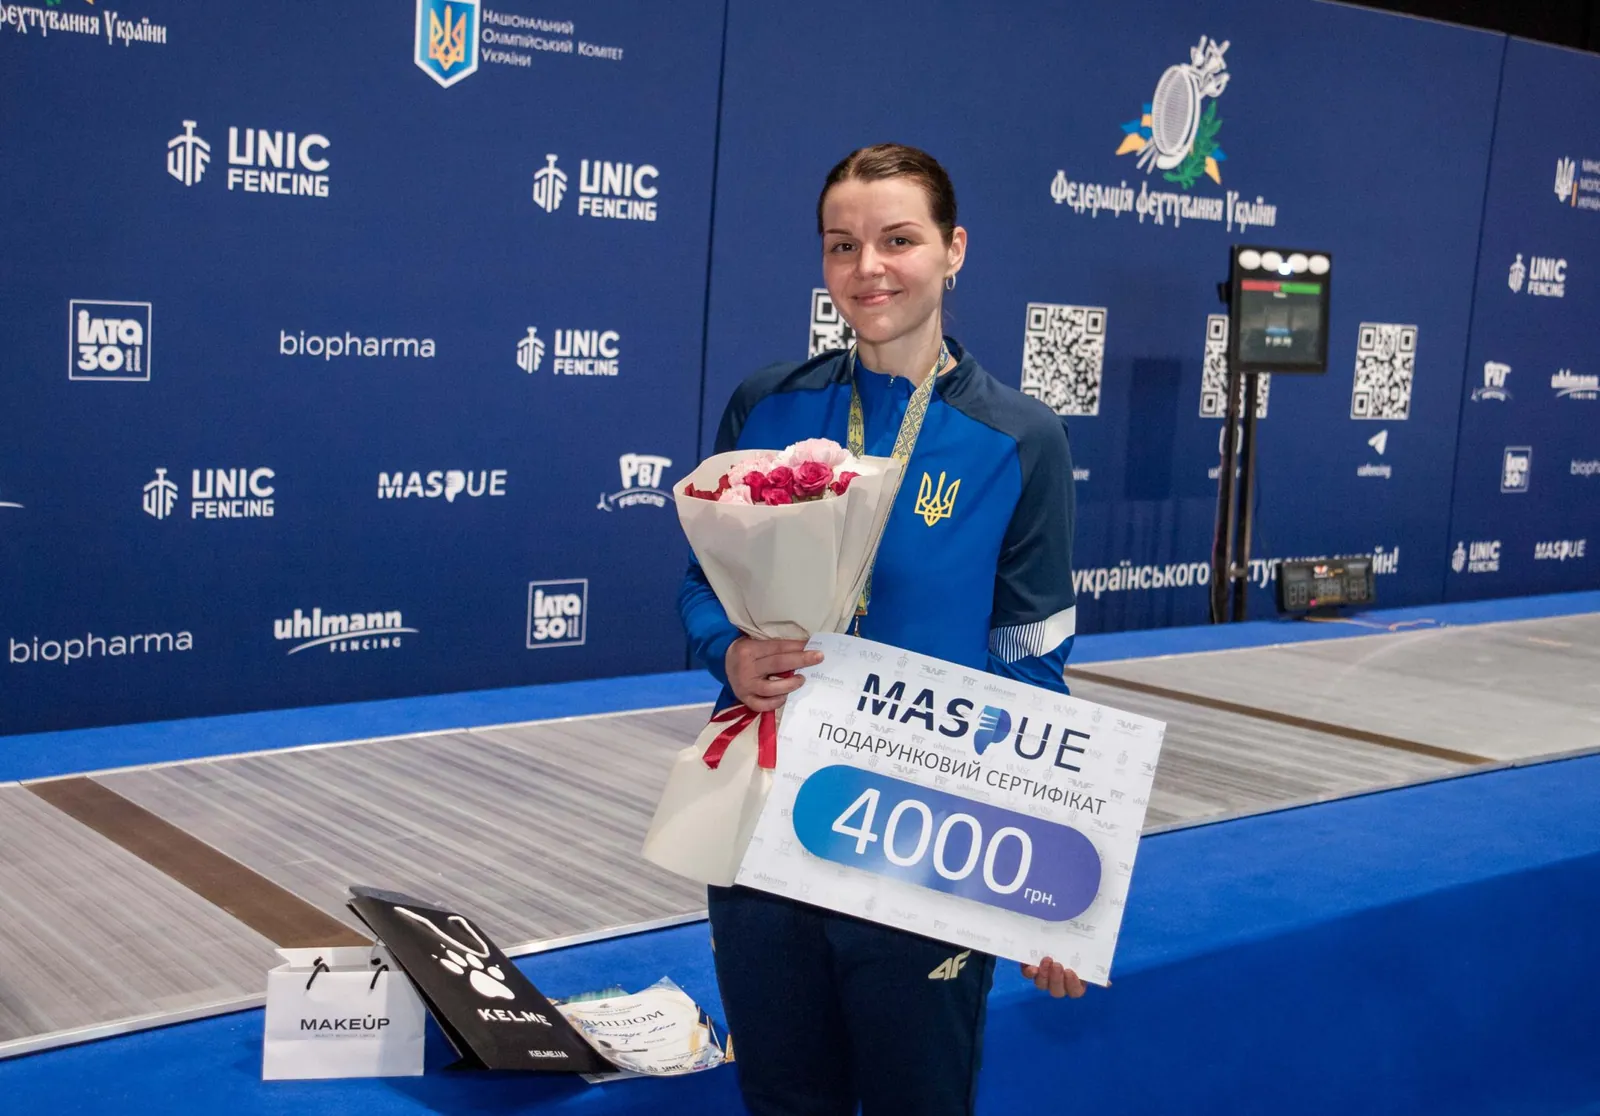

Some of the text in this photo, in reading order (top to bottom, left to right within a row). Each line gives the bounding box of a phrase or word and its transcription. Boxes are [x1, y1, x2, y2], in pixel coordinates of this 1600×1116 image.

[104, 10, 167, 47] України
[228, 126, 331, 172] UNIC
[227, 168, 329, 198] FENCING
[579, 159, 659, 199] UNIC
[578, 196, 657, 221] FENCING
[1050, 169, 1277, 234] Федерація фехтування України
[1529, 256, 1568, 282] UNIC
[1527, 281, 1565, 298] FENCING
[280, 330, 436, 361] biopharma
[554, 329, 620, 358] UNIC
[554, 358, 619, 376] FENCING
[192, 467, 275, 498] UNIC
[619, 453, 672, 489] PBT
[191, 499, 275, 519] FENCING
[1469, 540, 1501, 560] UNIC
[1072, 560, 1210, 599] українського
[274, 607, 402, 640] uhlmann
[9, 631, 193, 665] biopharma
[330, 637, 401, 653] FENCING
[818, 722, 1107, 816] ПОДАРУНКОВИЙ СЕРТИФІКАТ
[832, 788, 1057, 907] 4000 грн.
[477, 1008, 553, 1027] KELME
